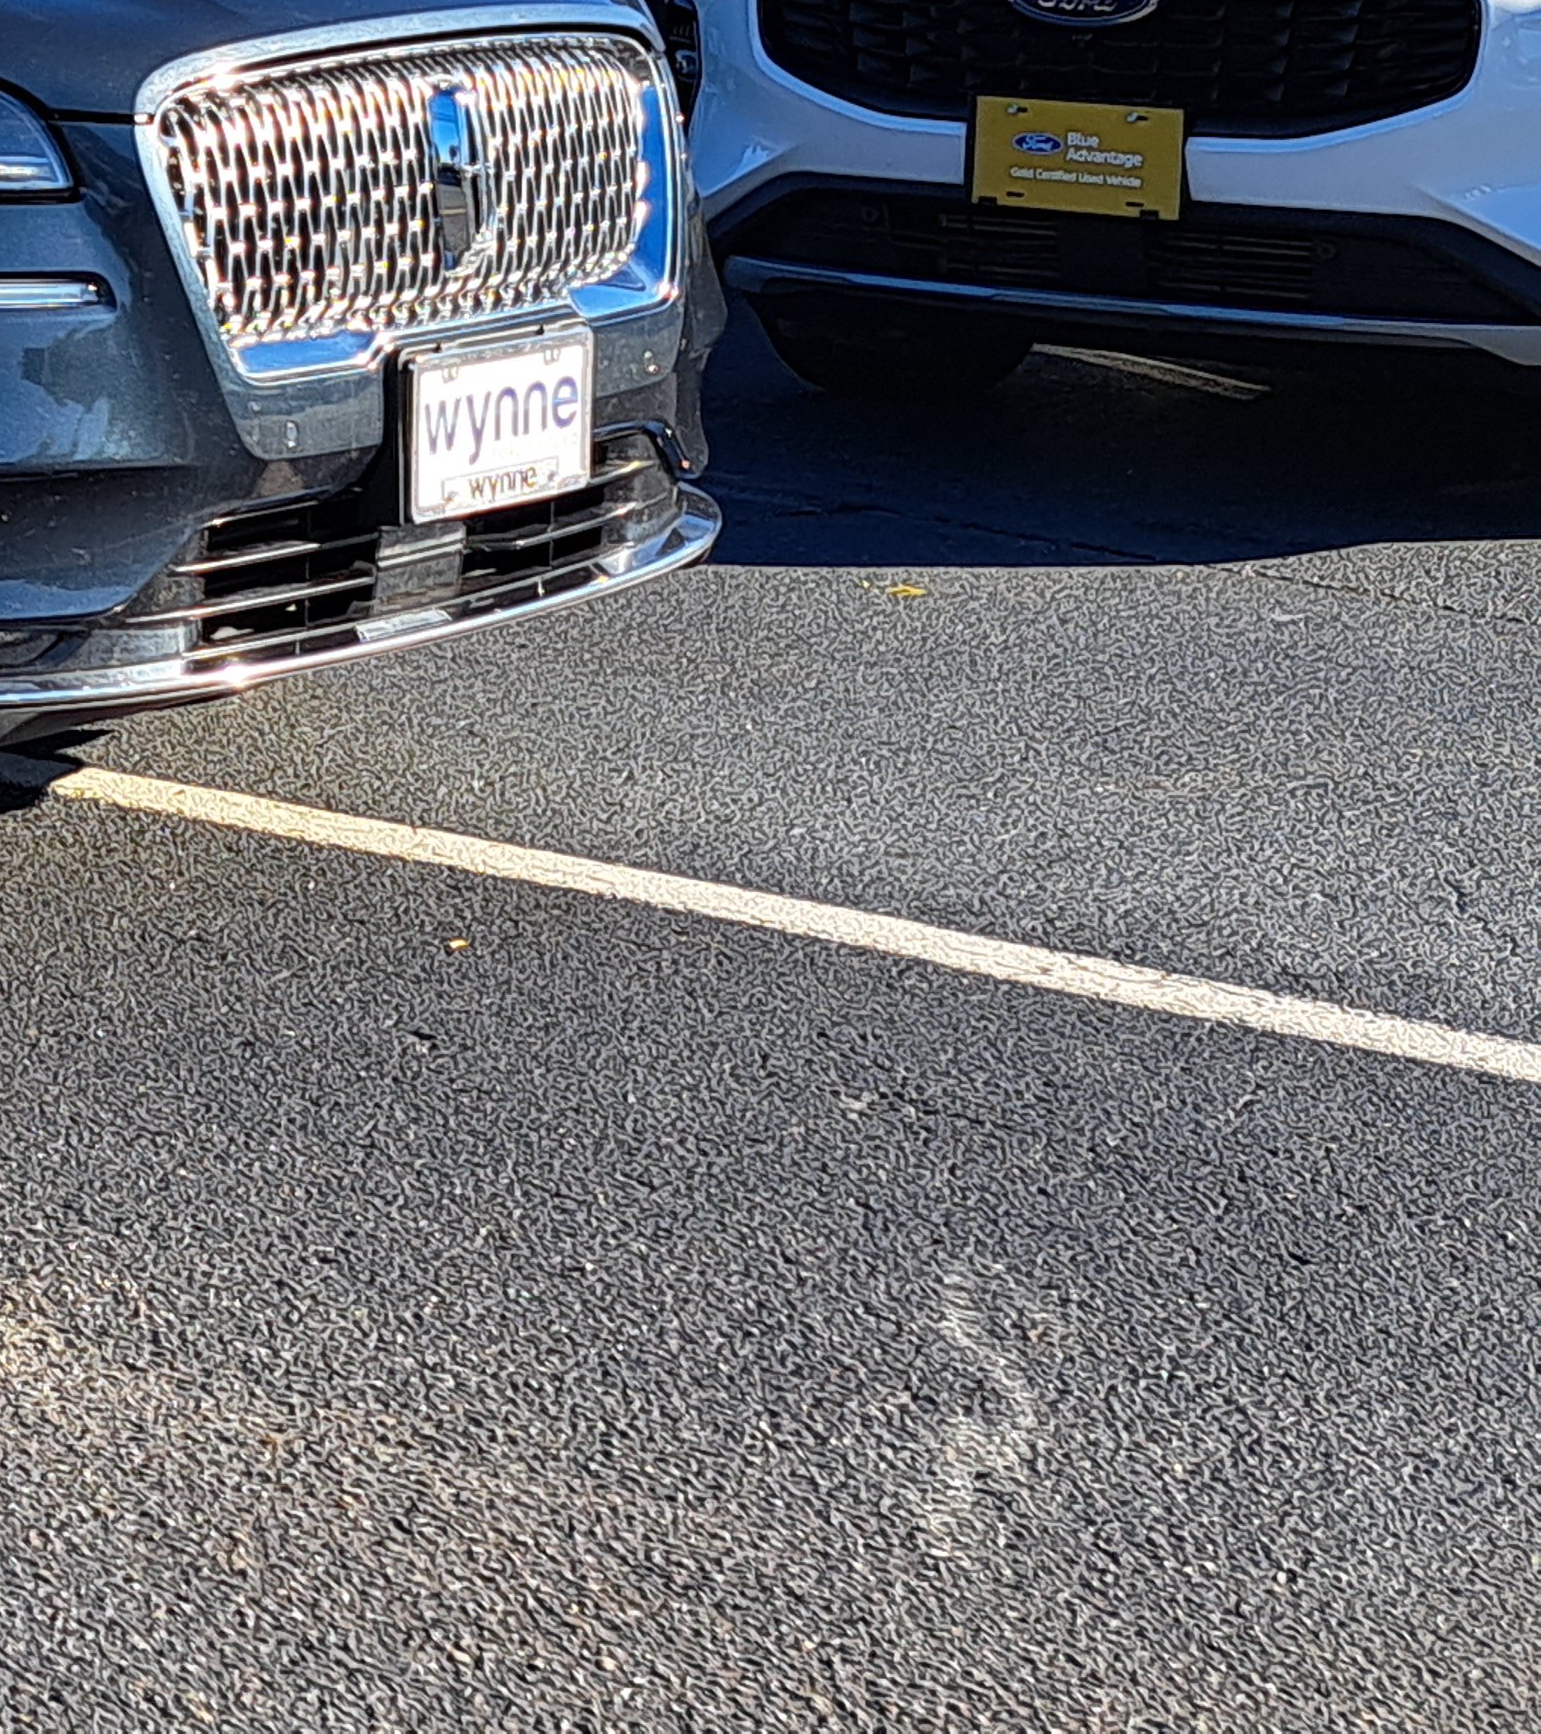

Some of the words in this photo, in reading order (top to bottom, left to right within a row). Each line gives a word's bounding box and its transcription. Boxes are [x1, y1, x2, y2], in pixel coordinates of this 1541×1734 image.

[1022, 134, 1054, 152] Ford
[1067, 132, 1100, 147] Blue
[1066, 147, 1143, 168] Advantage
[1010, 166, 1034, 178] Gold
[1036, 168, 1077, 182] Certified
[1078, 172, 1104, 184] Used
[1105, 174, 1142, 187] Vehicle
[424, 376, 579, 466] wynne
[468, 466, 538, 502] wynne
